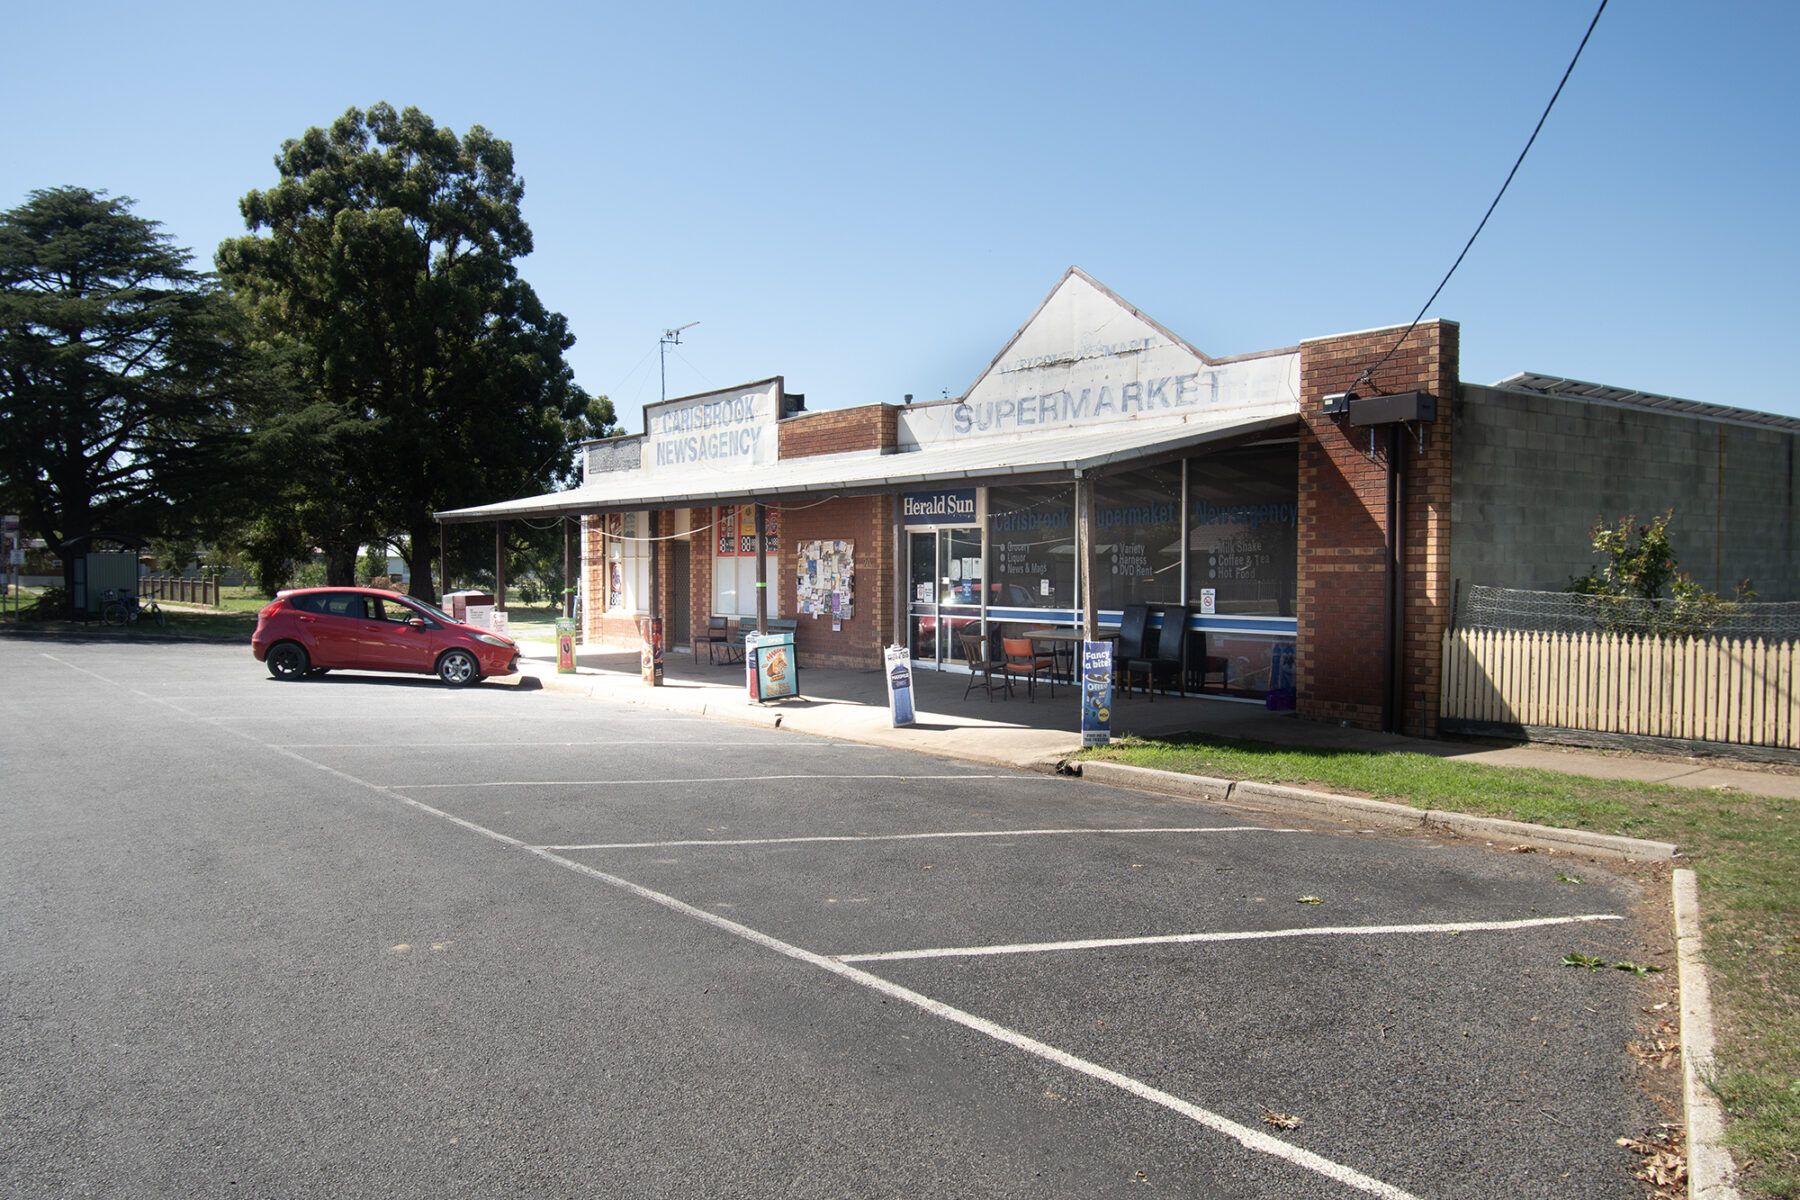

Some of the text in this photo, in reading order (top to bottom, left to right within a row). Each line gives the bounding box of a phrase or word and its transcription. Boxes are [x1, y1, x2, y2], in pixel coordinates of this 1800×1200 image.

[954, 369, 1228, 433] SUPERMARKET
[663, 396, 755, 435] CARISBROOK
[656, 426, 762, 466] NEWSAGENCY
[904, 494, 974, 516] Herald Sun
[994, 501, 1298, 531] Carisbrook upermaket Newsagency
[1007, 541, 1030, 554] Grocery
[1119, 543, 1145, 555] Variety
[1217, 539, 1236, 554] Milk
[1007, 553, 1026, 565] Liquor
[1119, 555, 1147, 565] Harness
[1218, 554, 1242, 566] Coffee
[1007, 562, 1047, 576] News & Mags
[1119, 566, 1153, 576] DVD Rent
[1218, 567, 1256, 579] Hot Food
[1086, 651, 1110, 661] Fancy
